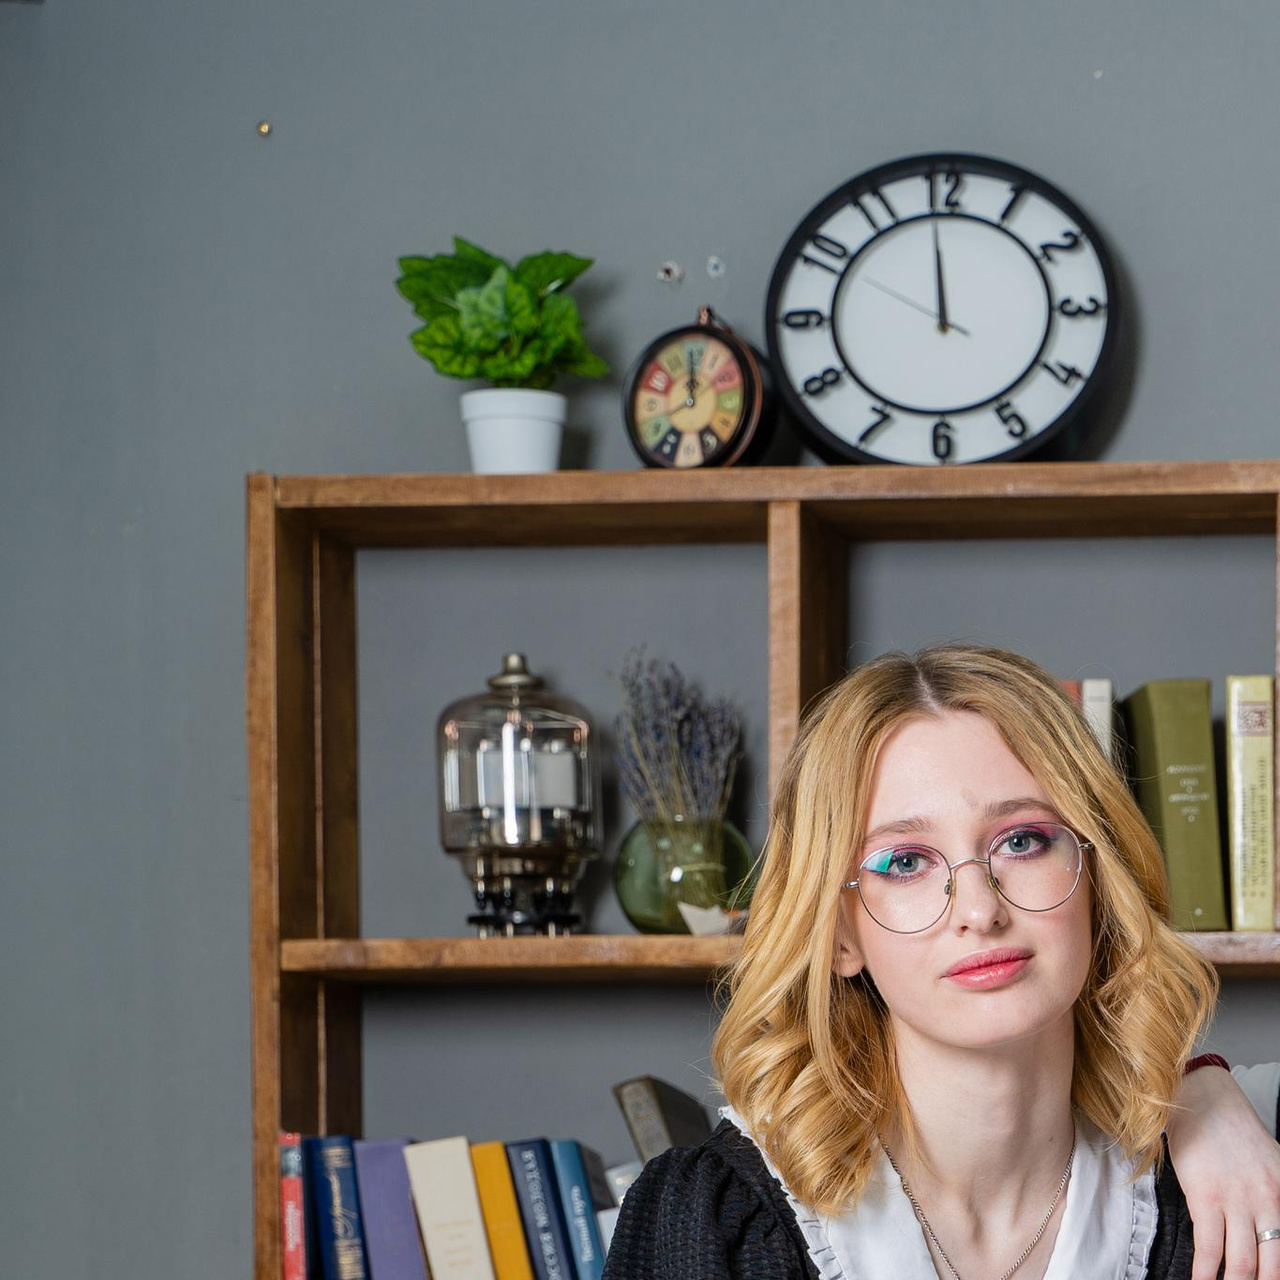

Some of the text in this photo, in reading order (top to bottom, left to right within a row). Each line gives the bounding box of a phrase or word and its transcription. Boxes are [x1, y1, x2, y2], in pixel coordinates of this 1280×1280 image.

[925, 167, 961, 210] 12
[1001, 181, 1030, 221] 1
[852, 184, 899, 234] 11
[800, 232, 848, 276] 10
[1040, 231, 1082, 263] 2
[783, 309, 825, 329] 9
[1059, 296, 1101, 317] 3
[803, 367, 840, 396] 8
[1042, 361, 1085, 385] 4
[858, 405, 892, 444] 7
[993, 401, 1027, 438] 5
[931, 420, 954, 461] 6
